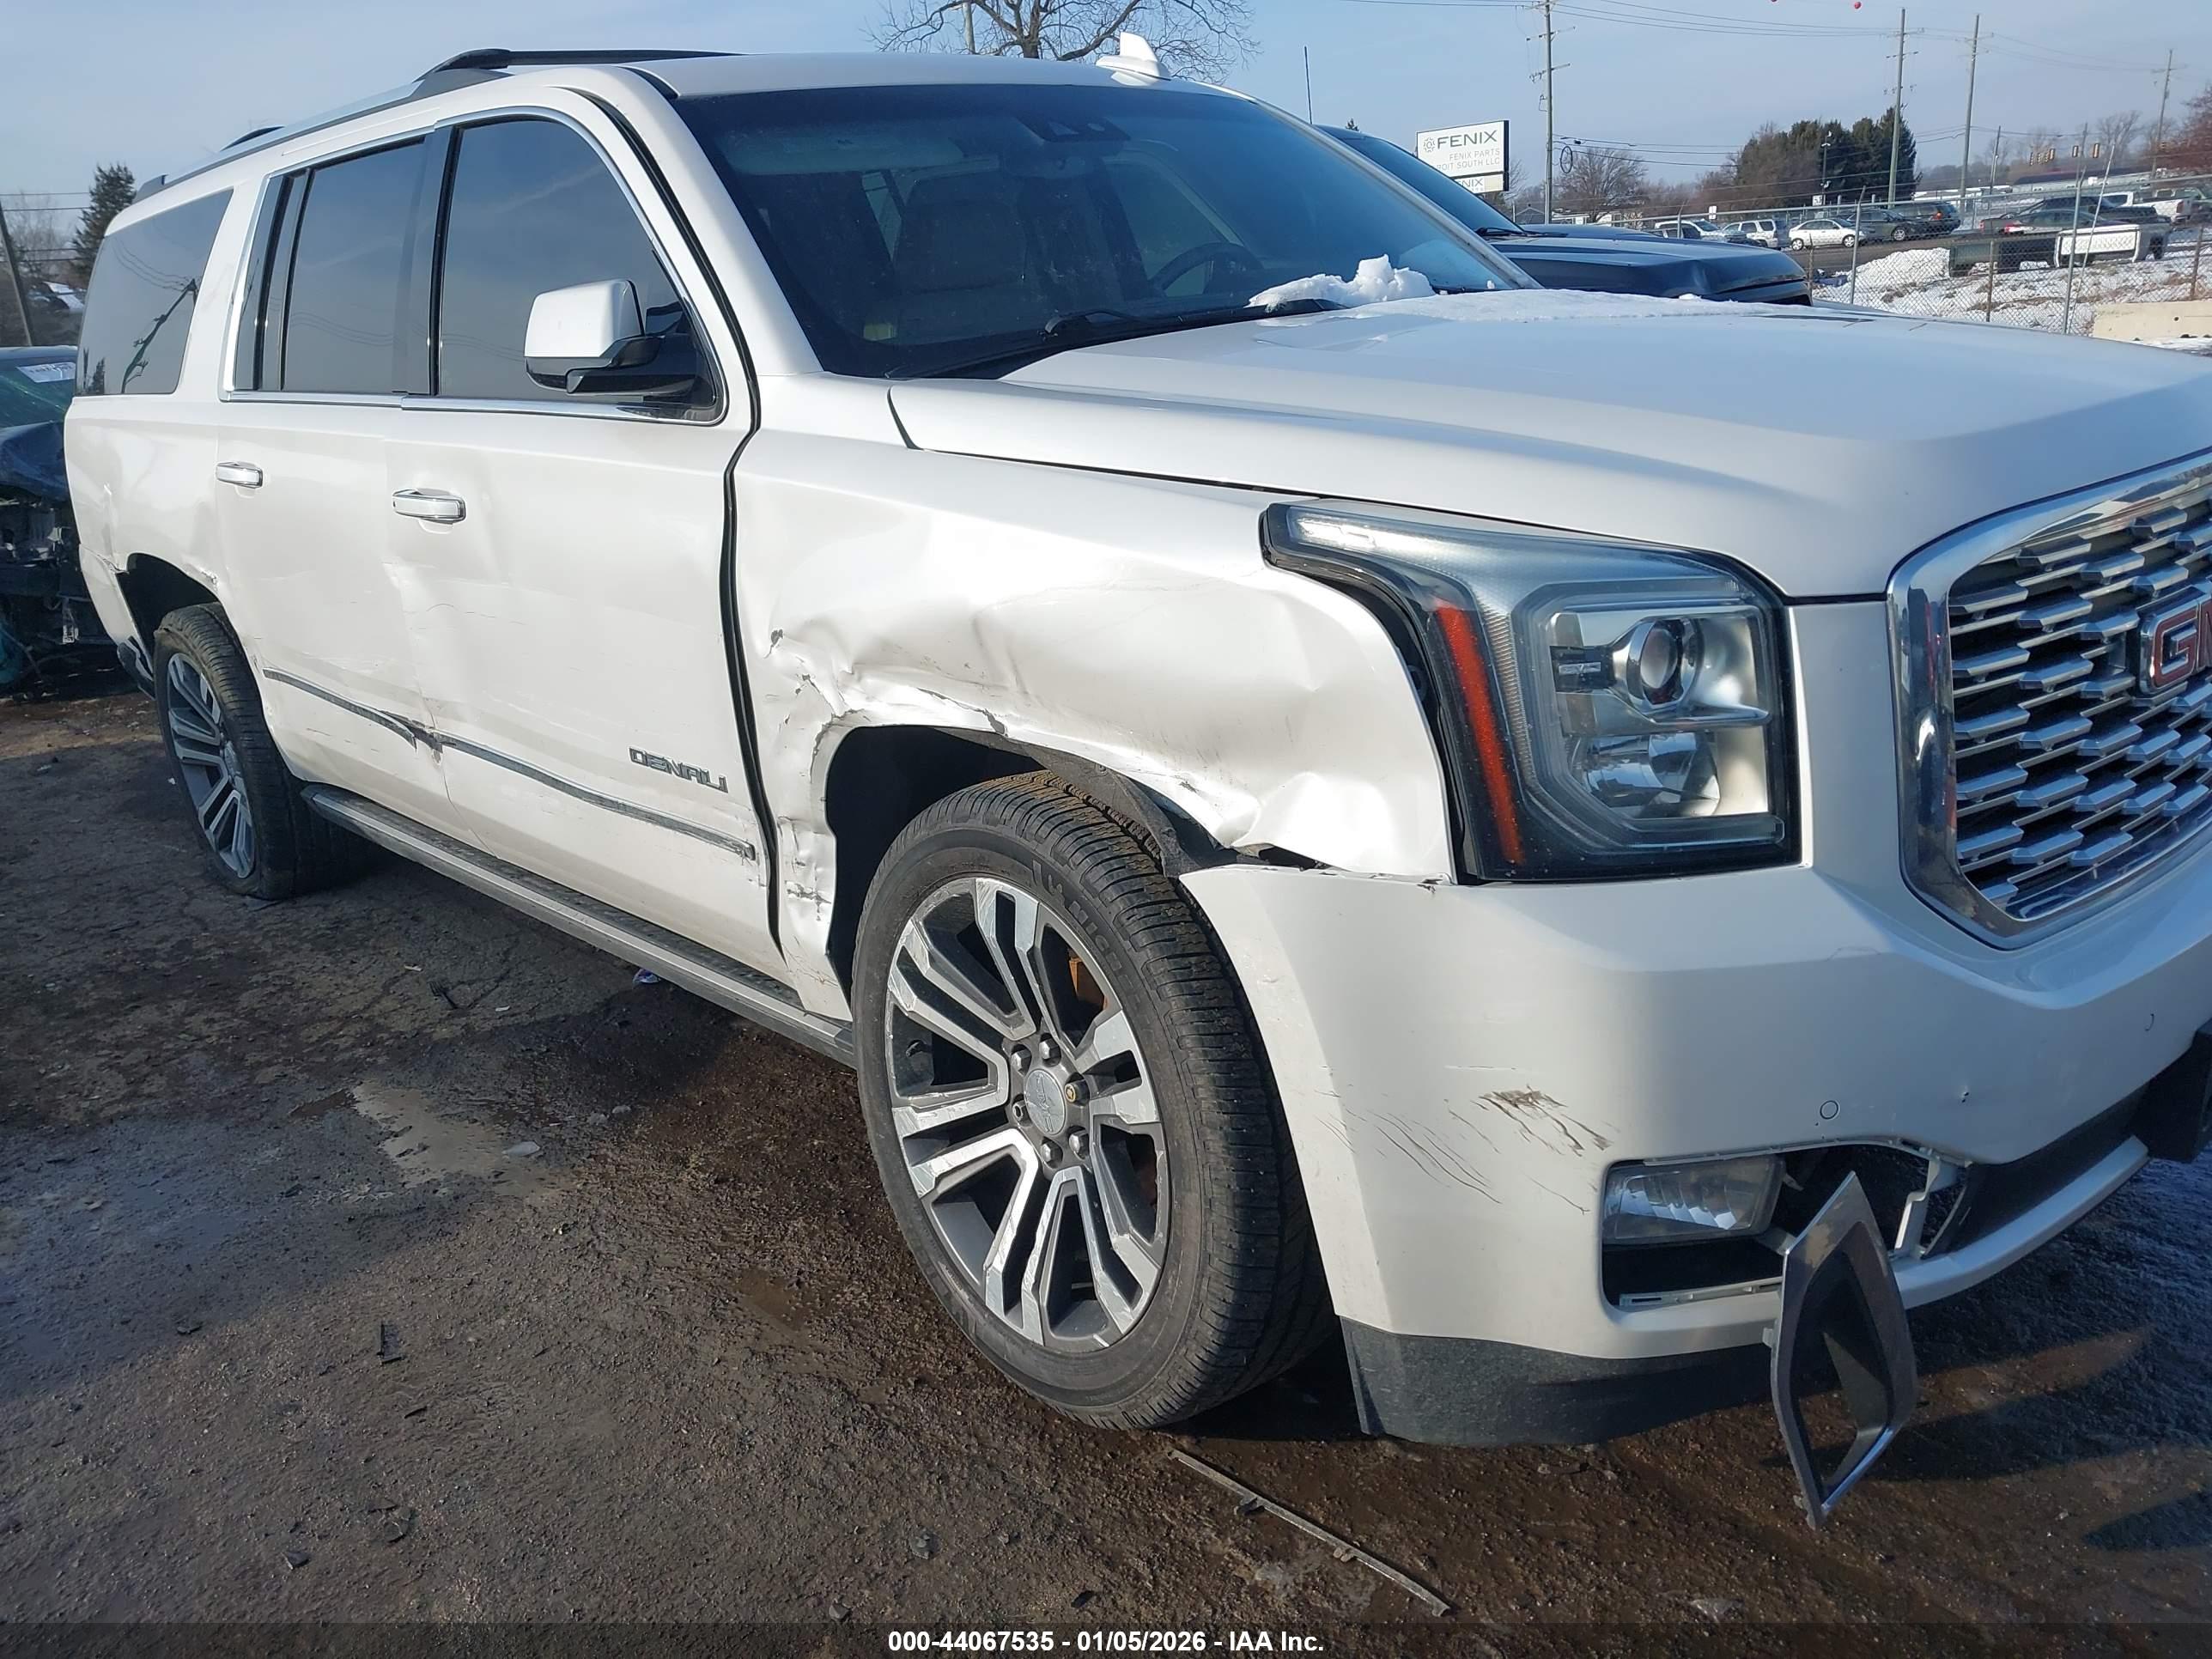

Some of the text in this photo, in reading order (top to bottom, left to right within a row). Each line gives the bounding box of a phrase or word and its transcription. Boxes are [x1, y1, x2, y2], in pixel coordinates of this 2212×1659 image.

[1437, 131, 1497, 149] FENIX
[1449, 149, 1499, 161] FENIX PARTS
[1457, 160, 1483, 169] SOUTH
[1486, 157, 1500, 166] LLC
[629, 746, 729, 793] DENALI
